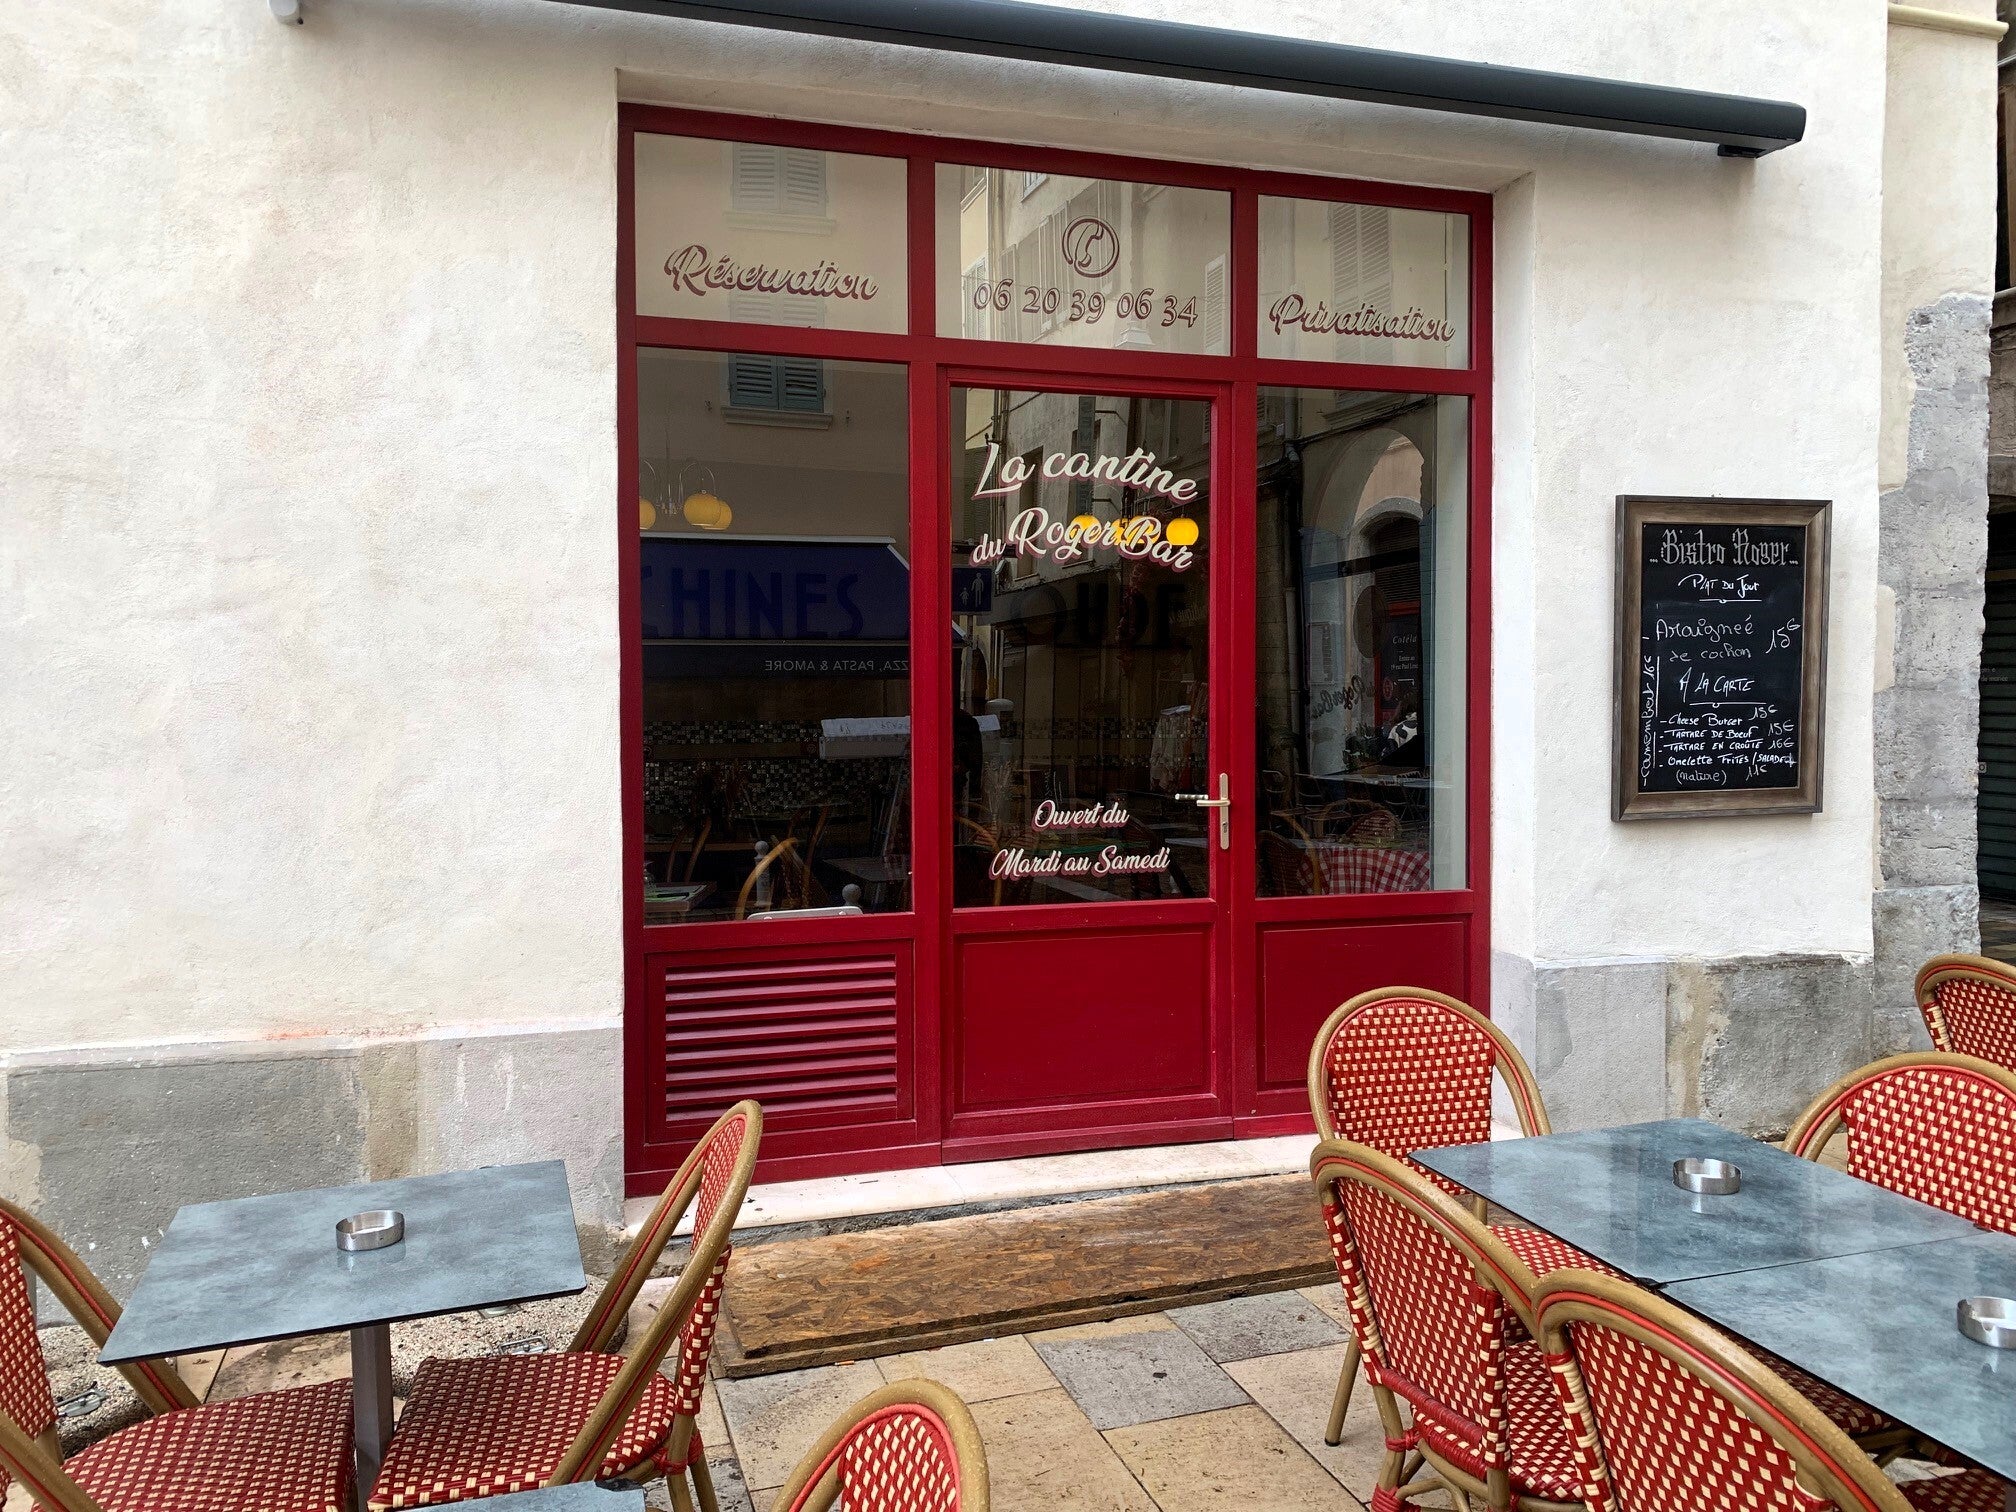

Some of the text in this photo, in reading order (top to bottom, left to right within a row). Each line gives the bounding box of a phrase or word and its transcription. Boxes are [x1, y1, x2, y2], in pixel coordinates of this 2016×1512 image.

[664, 244, 879, 300] Réservation
[973, 278, 1199, 328] 06 20 39 06 34
[1269, 293, 1456, 342] Privatisation
[972, 442, 1036, 500] La
[1042, 446, 1199, 505] cantine
[969, 506, 1194, 573] du Roger Bar
[1031, 799, 1130, 831] Ouvert du
[989, 845, 1171, 881] Mardi au Samedi
